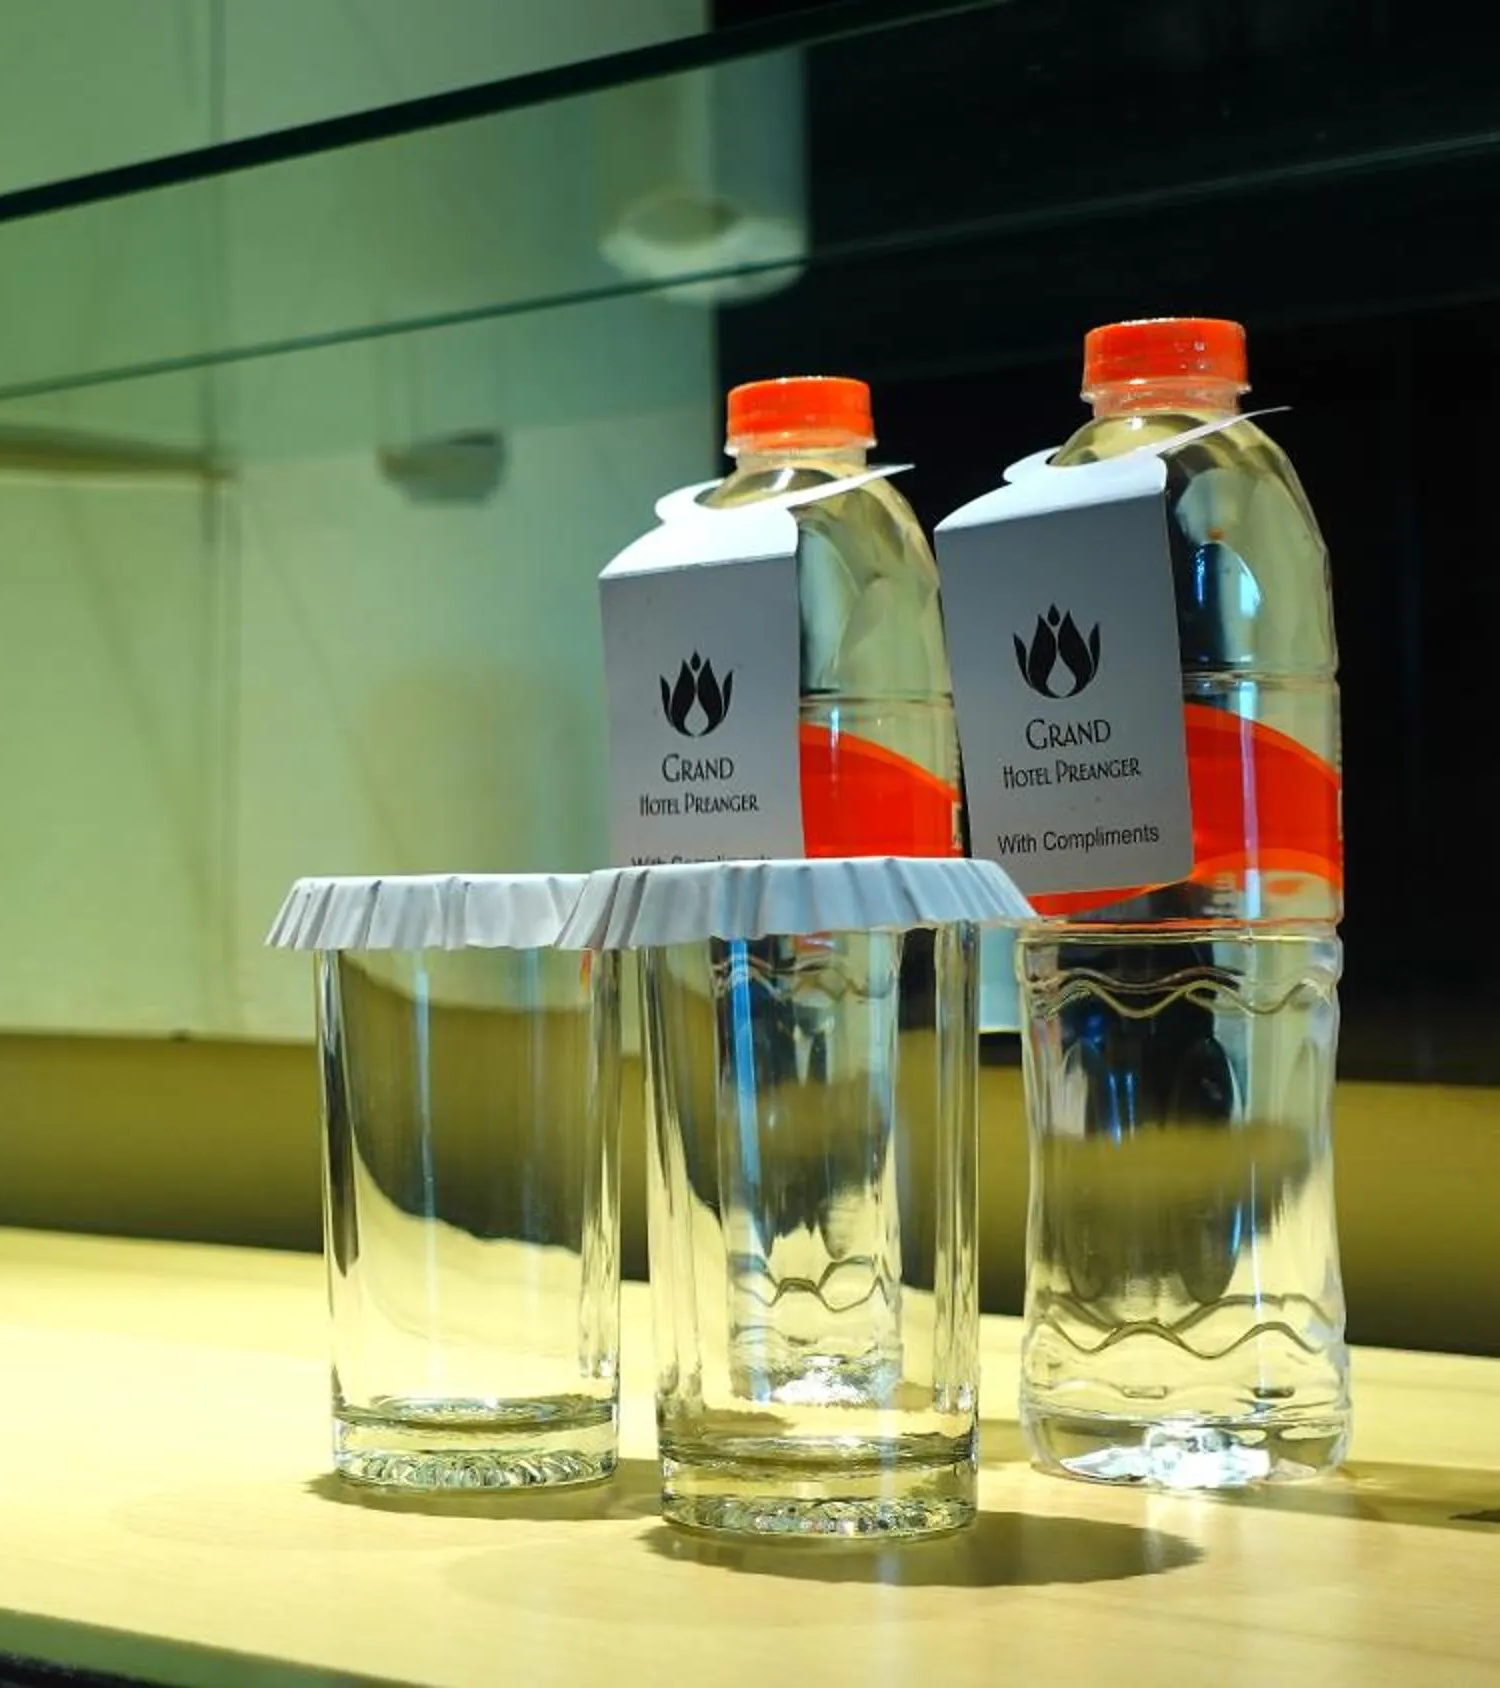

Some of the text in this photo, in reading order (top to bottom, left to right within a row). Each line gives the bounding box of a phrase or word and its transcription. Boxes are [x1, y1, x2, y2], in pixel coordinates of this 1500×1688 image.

[1026, 718, 1111, 750] GRAND
[662, 753, 734, 782] GRAND
[1003, 757, 1141, 789] HOTEL PREANGER
[640, 791, 760, 816] HOTEL PREANGER
[998, 823, 1160, 854] With Compliments
